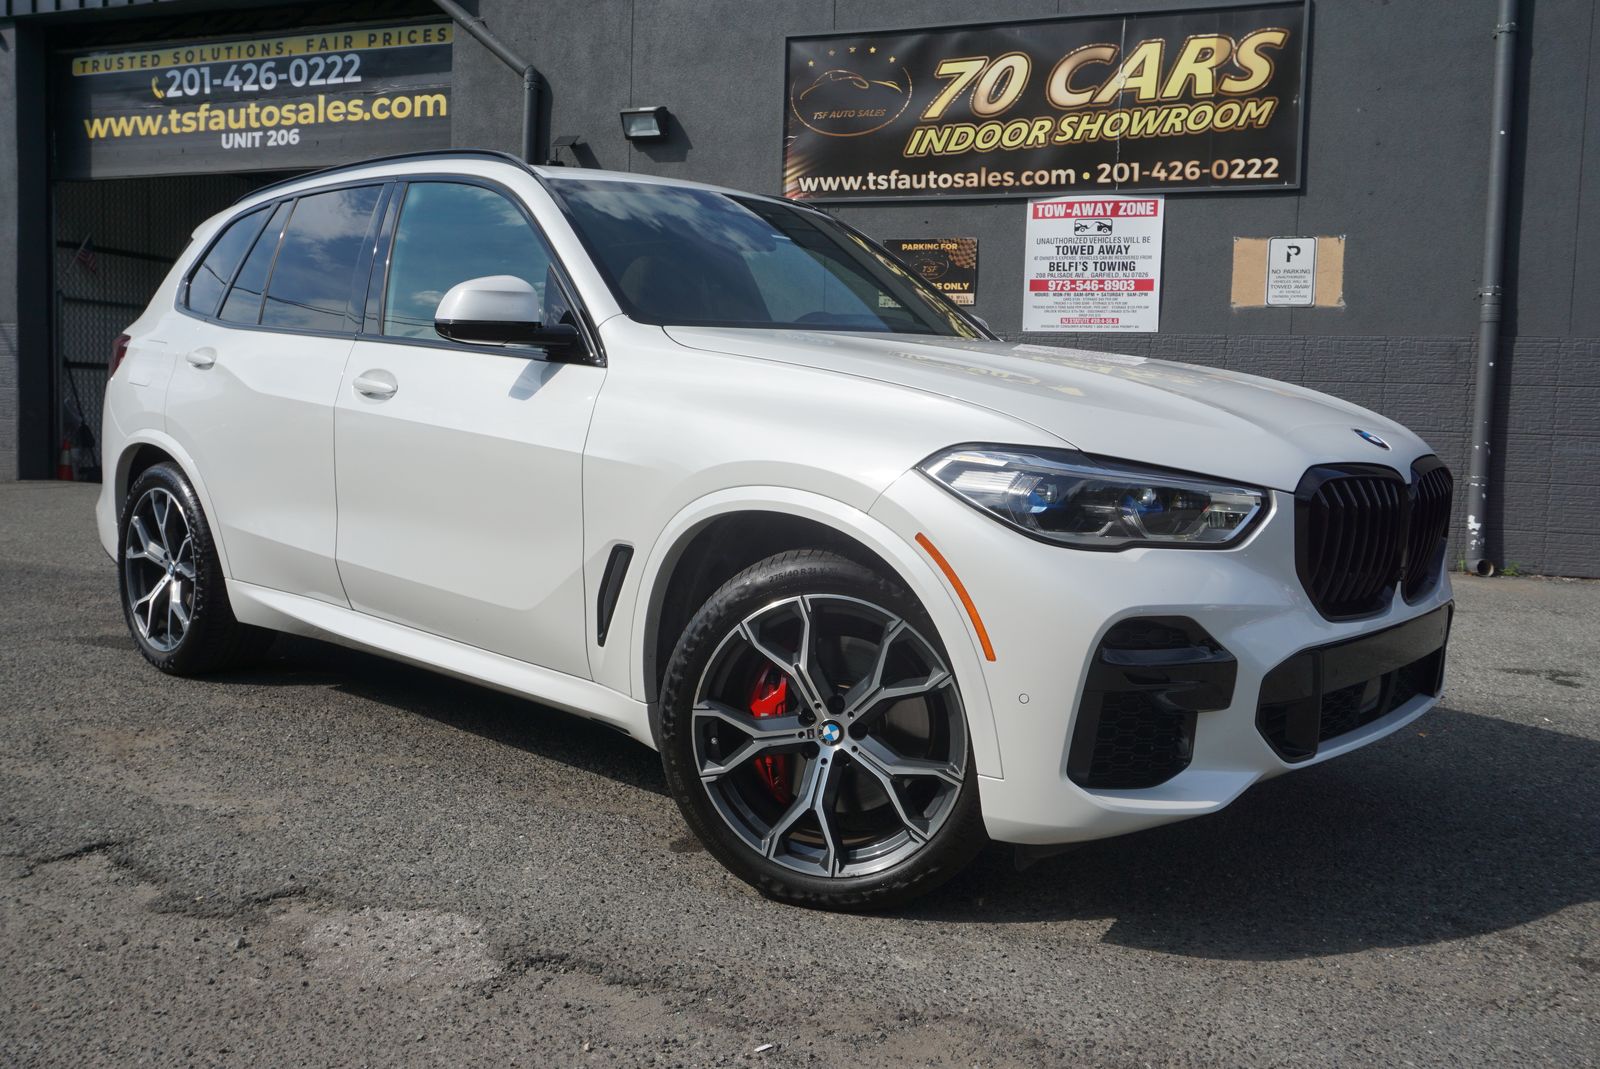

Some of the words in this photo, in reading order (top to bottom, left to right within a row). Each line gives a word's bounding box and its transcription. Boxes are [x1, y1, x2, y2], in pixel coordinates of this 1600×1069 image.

[80, 54, 161, 73] TRUSTED
[172, 42, 293, 65] SOLUTIONS,
[306, 35, 353, 51] FAIR
[367, 27, 448, 47] PRICES
[165, 53, 362, 98] 201-426-0222
[922, 53, 1030, 120] 70
[1046, 28, 1289, 108] CARS
[84, 93, 447, 140] www.tsfautosales.com
[812, 111, 829, 120] TSF
[829, 109, 855, 119] AUTO
[857, 108, 887, 118] SALES
[903, 118, 1049, 156] INDOOR
[1054, 99, 1277, 143] SHOWROOM
[221, 132, 261, 149] UNIT
[266, 128, 300, 147] 206
[799, 166, 1076, 192] www.tsfautosales.com
[1097, 158, 1280, 184] 201-426-0222
[1036, 203, 1114, 217] TOW-AWAY
[1118, 202, 1155, 215] ZONE
[901, 243, 940, 251] PARKING
[1036, 237, 1088, 245] UNAUTHORIZED
[1089, 236, 1122, 244] VEHICLES
[1055, 245, 1094, 255] TOWED
[1098, 244, 1131, 255] AWAY
[922, 265, 937, 273] TSF
[1049, 261, 1088, 272] BELFI'S
[1093, 261, 1136, 271] TOWING
[943, 282, 969, 290] ONLY
[1048, 280, 1135, 291] 973-546-8903
